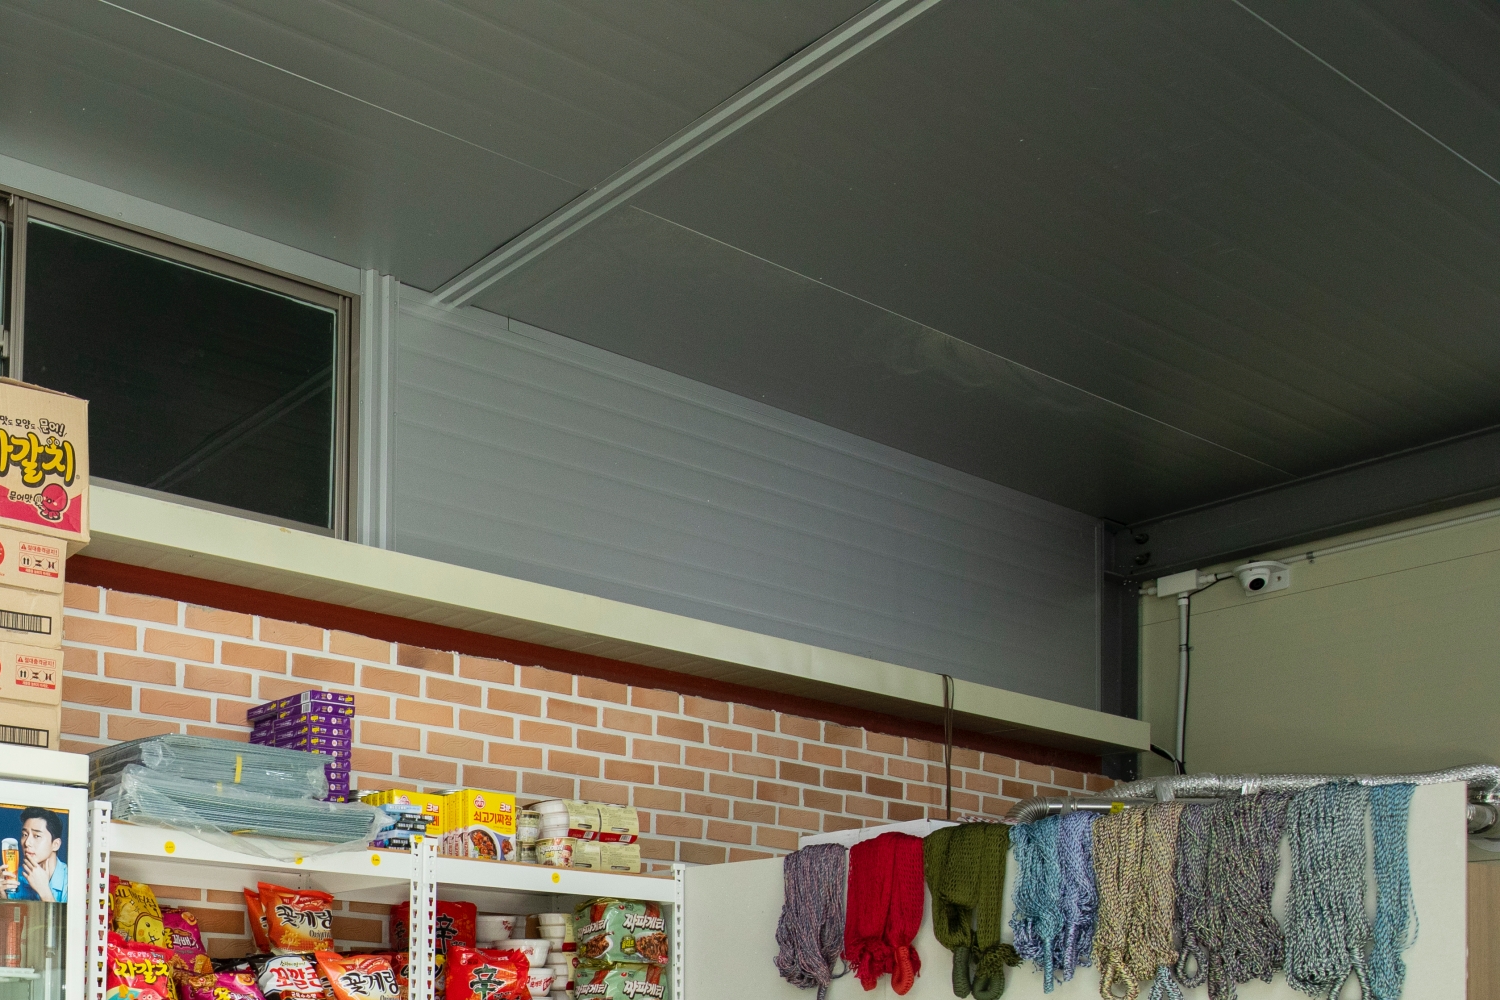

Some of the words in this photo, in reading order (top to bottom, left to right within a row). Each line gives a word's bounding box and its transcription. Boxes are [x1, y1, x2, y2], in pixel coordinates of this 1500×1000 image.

[0, 415, 13, 426] 맛도
[15, 418, 36, 430] 모양도
[38, 418, 66, 436] 문어!
[8, 490, 33, 503] 문어맛
[499, 802, 512, 813] 3분
[473, 810, 513, 826] 쇠고기짜장
[623, 913, 666, 933] 짜파게티
[343, 969, 399, 996] 꽃게랑
[623, 981, 665, 999] 짜파게티
